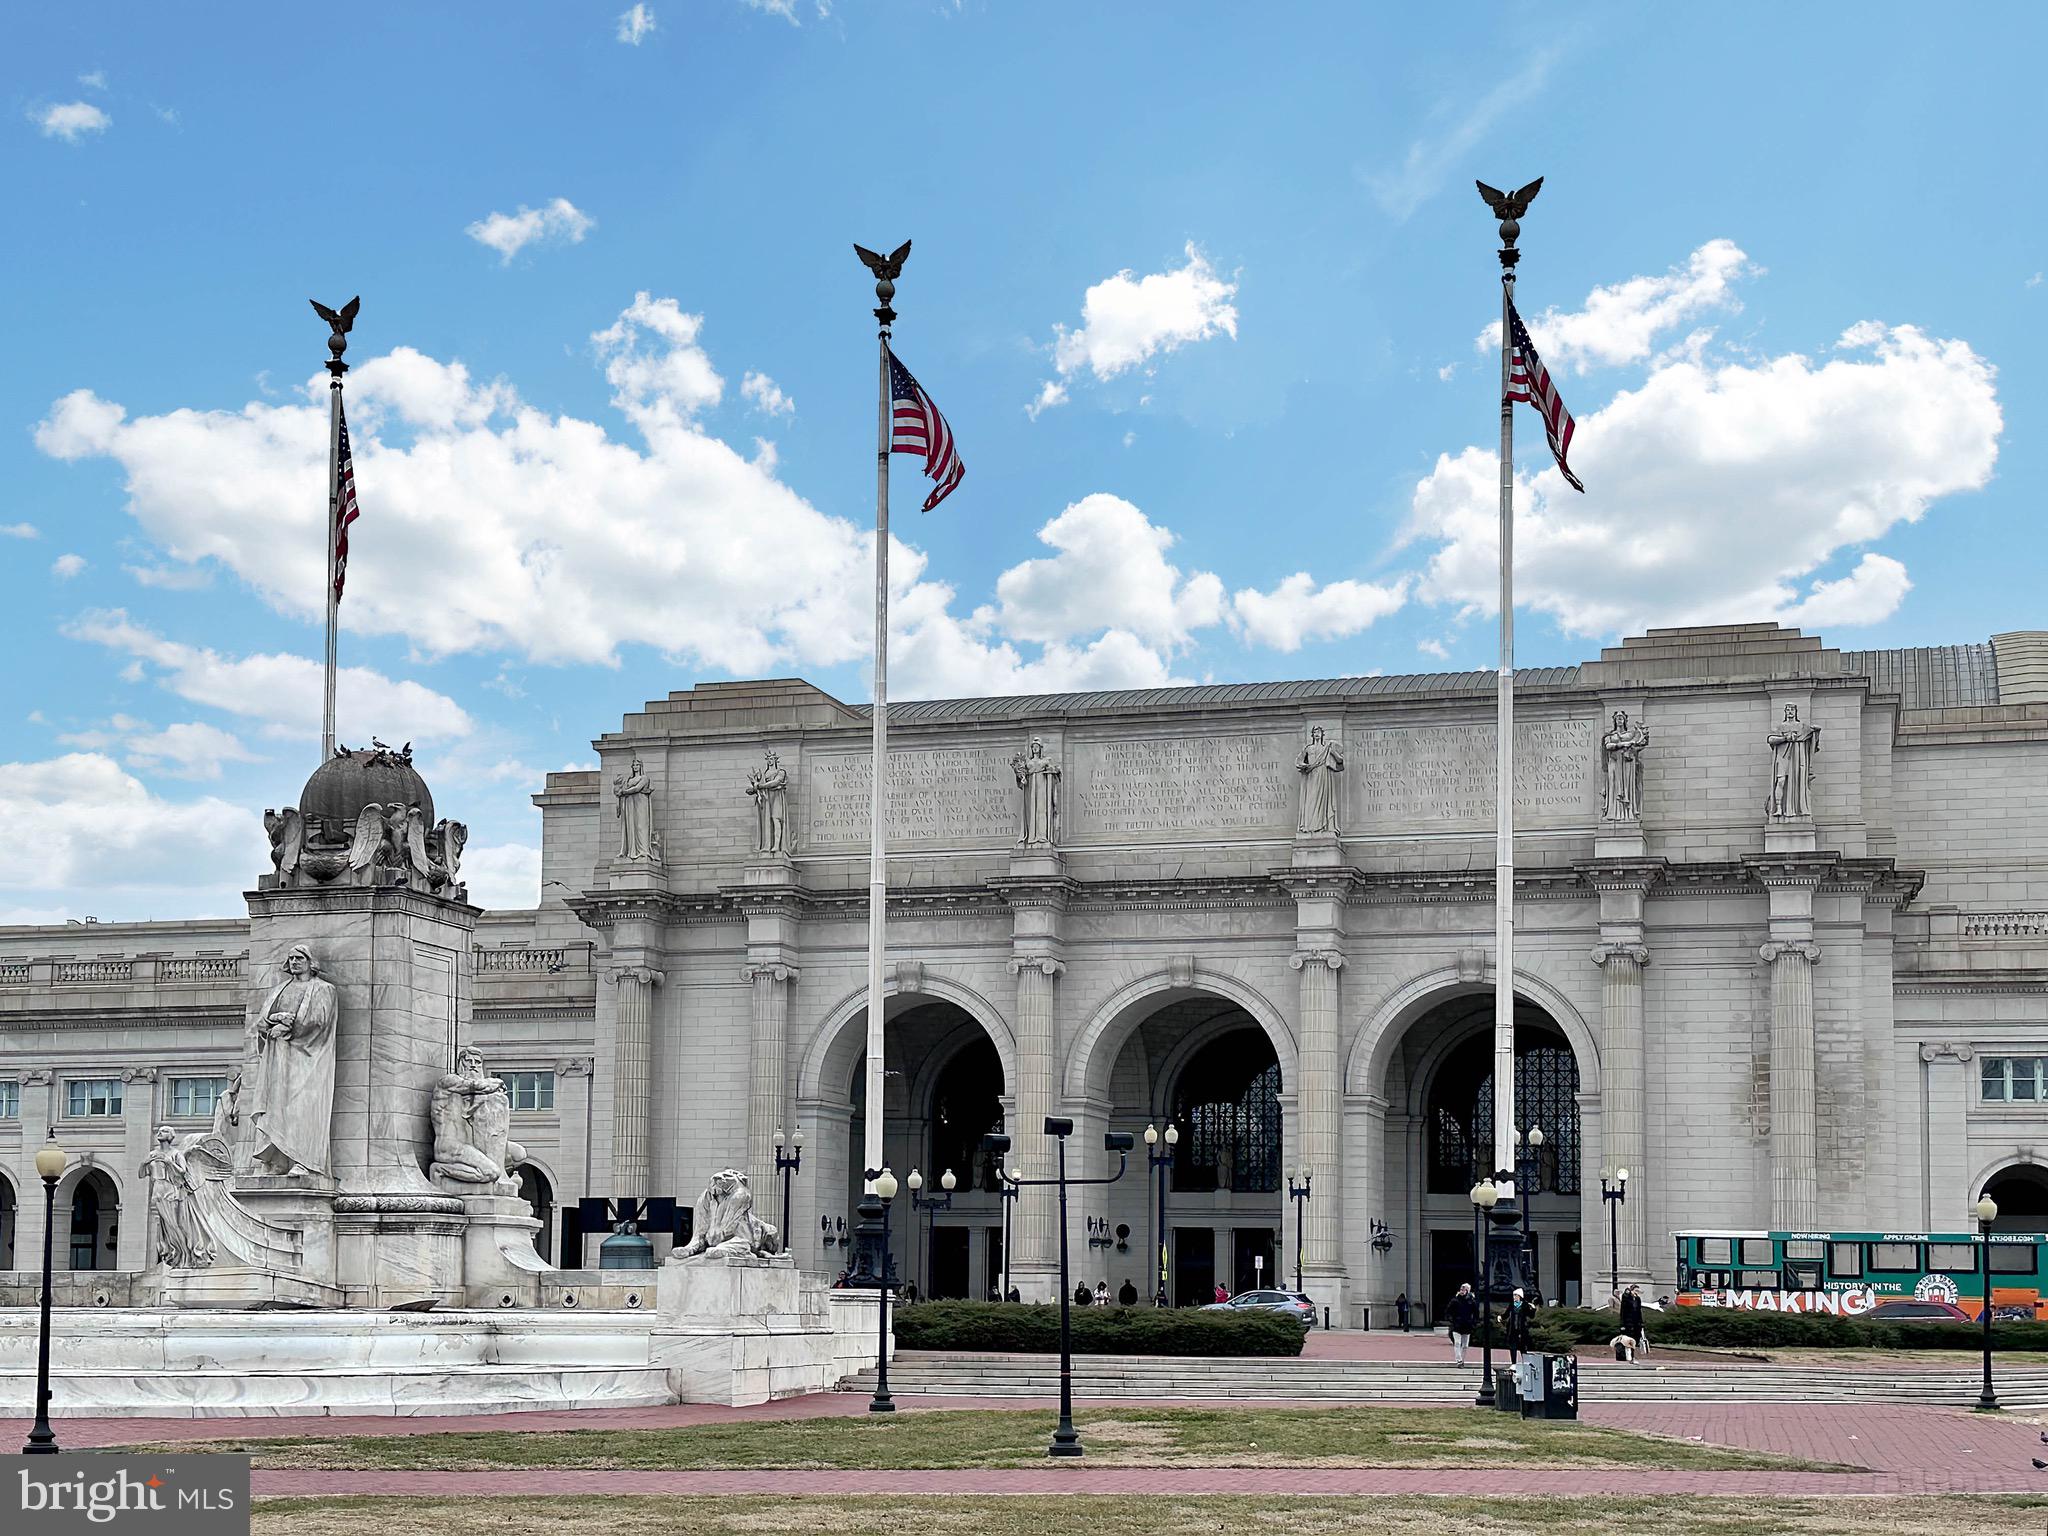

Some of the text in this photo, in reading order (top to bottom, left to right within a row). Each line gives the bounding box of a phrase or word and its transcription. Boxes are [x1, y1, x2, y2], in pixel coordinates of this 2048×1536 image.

[1164, 740, 1174, 749] OF
[1148, 749, 1160, 759] OF
[1164, 748, 1182, 758] LIFE
[1171, 765, 1182, 775] OF
[1236, 760, 1280, 772] THOUGHT
[1546, 763, 1581, 773] GOODS
[921, 776, 932, 785] TO
[1535, 780, 1580, 792] THOUGHT
[918, 790, 928, 799] OF
[1536, 795, 1582, 806] BLOSSOM
[1142, 806, 1160, 815] AND
[1823, 1282, 1902, 1291] HISTORY IN THE
